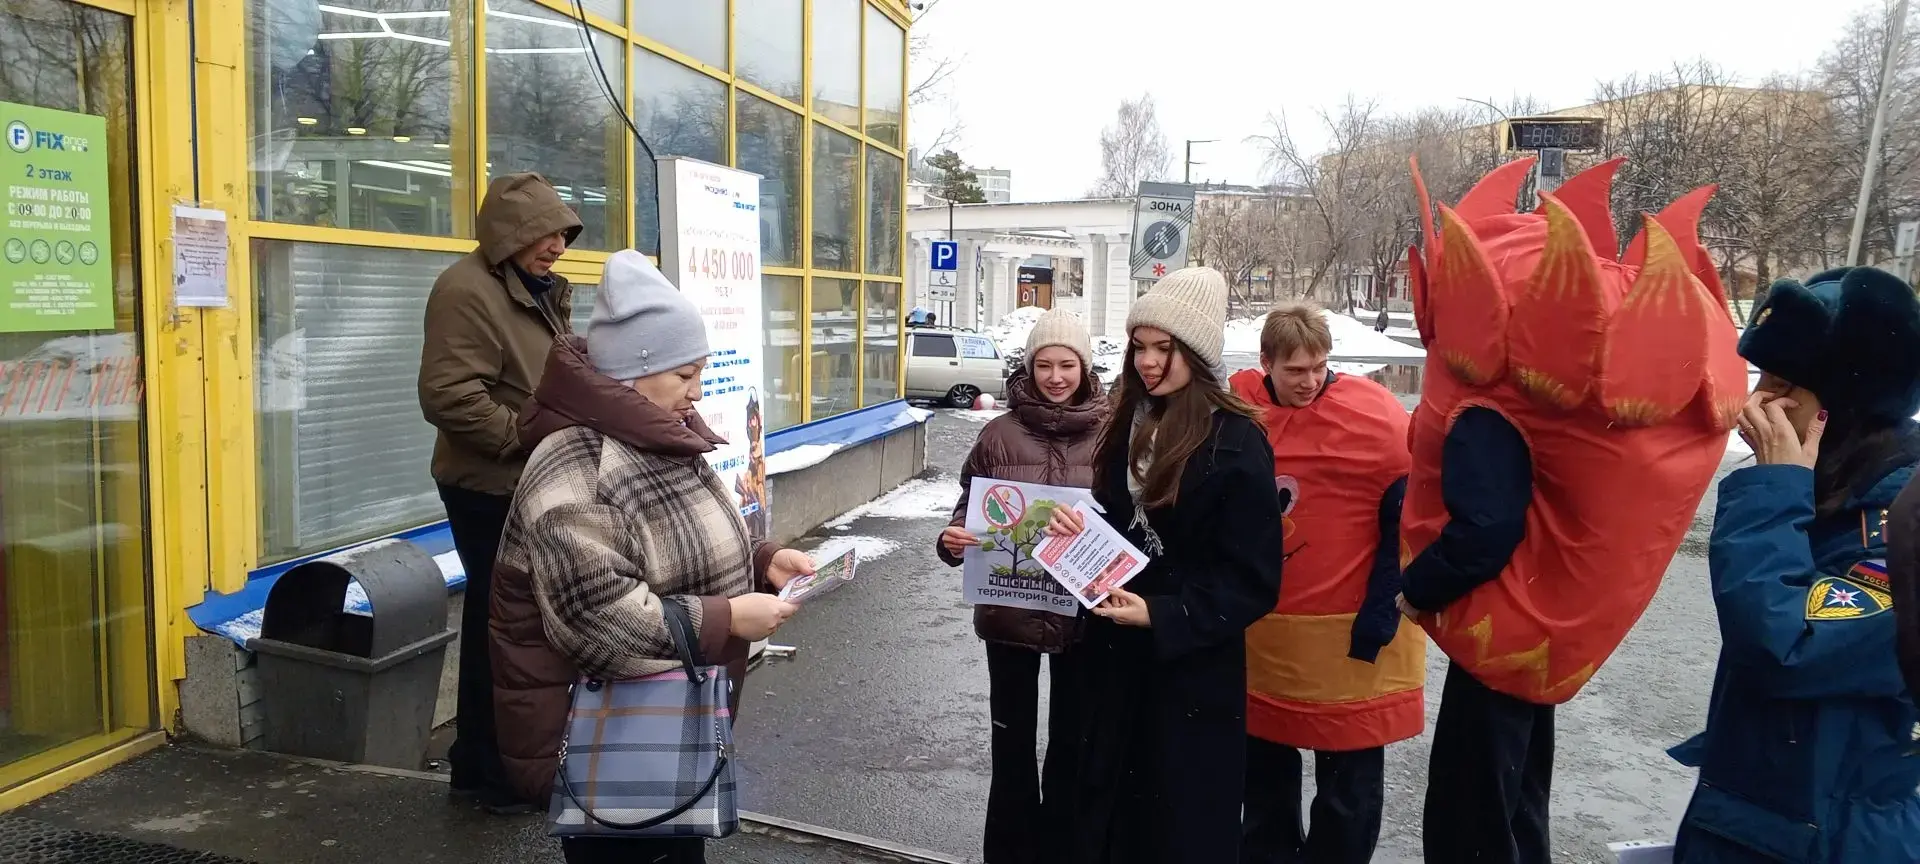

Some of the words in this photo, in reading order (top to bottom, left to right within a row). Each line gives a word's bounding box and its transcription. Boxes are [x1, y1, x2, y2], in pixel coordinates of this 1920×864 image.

[14, 128, 24, 146] F
[26, 164, 34, 178] 2
[39, 168, 72, 181] этаж
[9, 185, 48, 200] РЕЖИМ
[50, 189, 89, 204] РАБОТЫ
[48, 205, 62, 219] ДО
[1150, 201, 1182, 212] ЗОНА
[688, 247, 697, 278] 4
[702, 248, 727, 280] 450
[732, 252, 754, 280] 000
[937, 244, 953, 268] P
[977, 588, 1048, 601] территория
[1052, 596, 1072, 606] без
